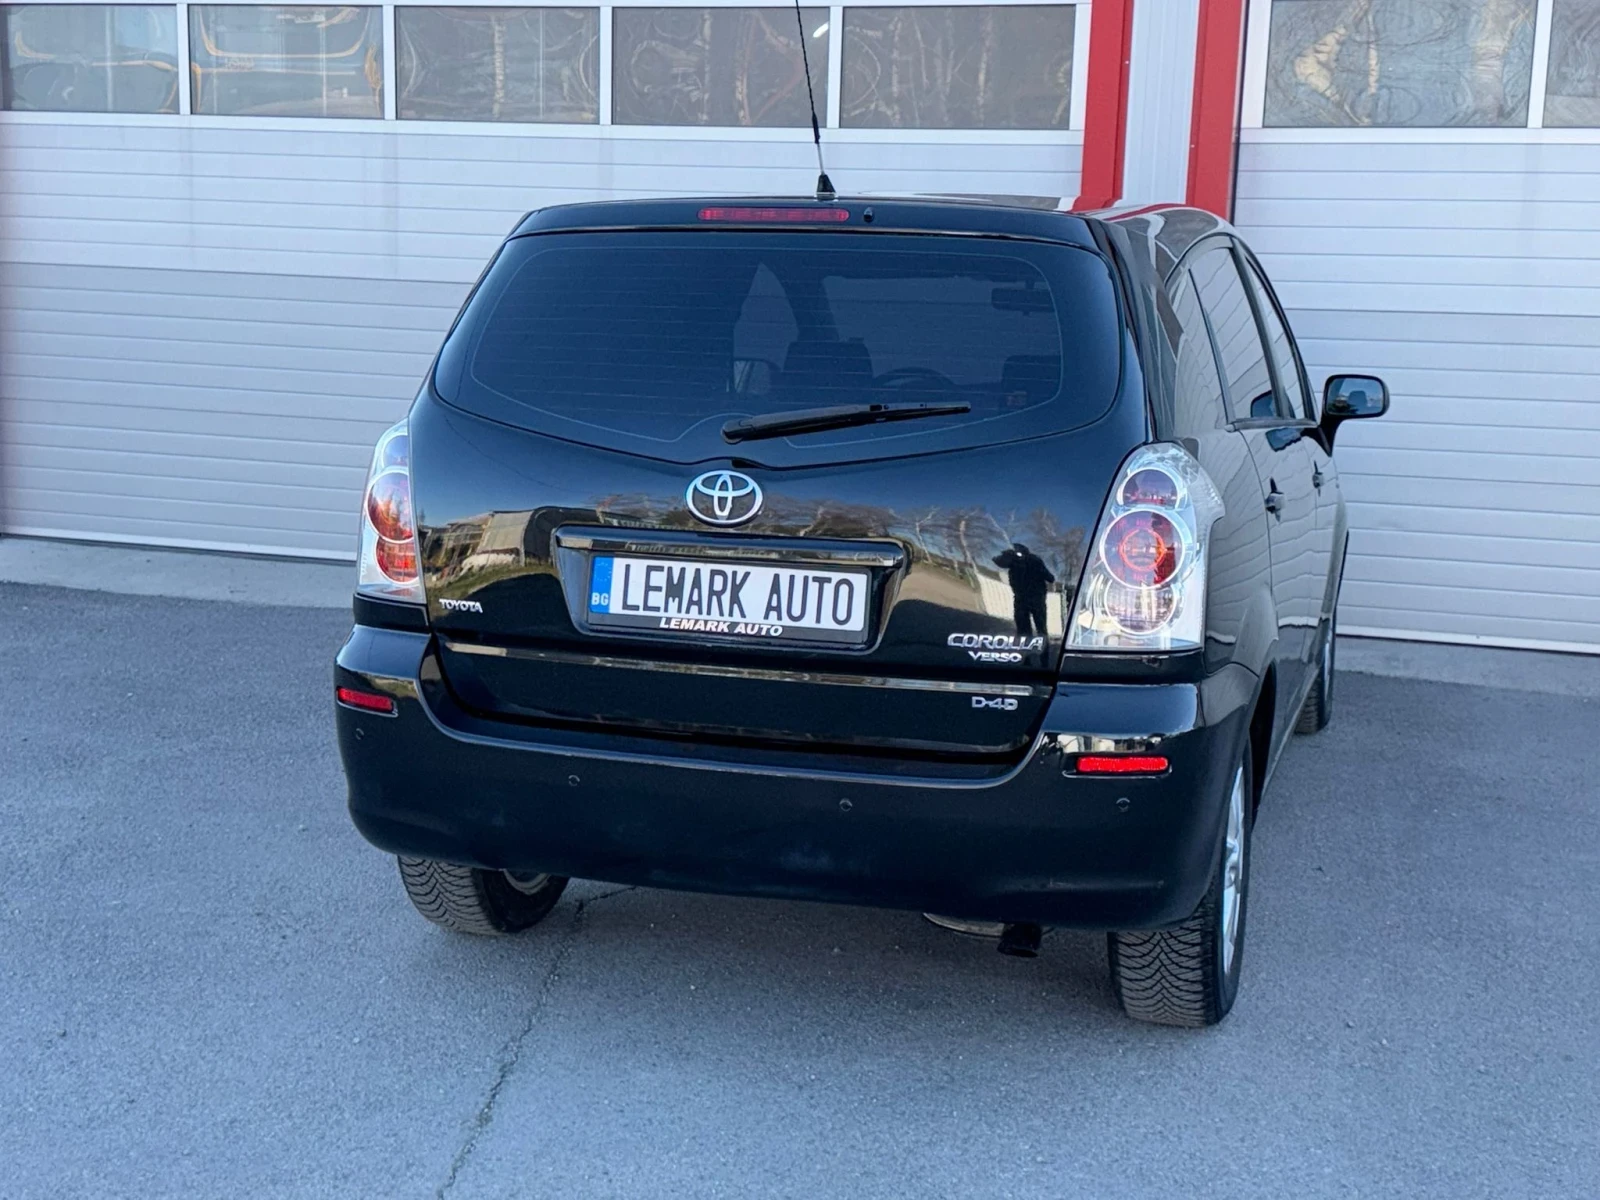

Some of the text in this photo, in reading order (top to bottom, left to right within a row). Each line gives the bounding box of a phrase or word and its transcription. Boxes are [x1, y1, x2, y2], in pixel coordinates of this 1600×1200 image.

[591, 593, 609, 606] BG
[621, 563, 854, 626] LEMARK AUTO
[439, 598, 483, 613] TOYOTA
[659, 617, 783, 637] LEMARK AUTO
[947, 633, 1044, 650] COROLLA
[968, 651, 1022, 662] VERSO
